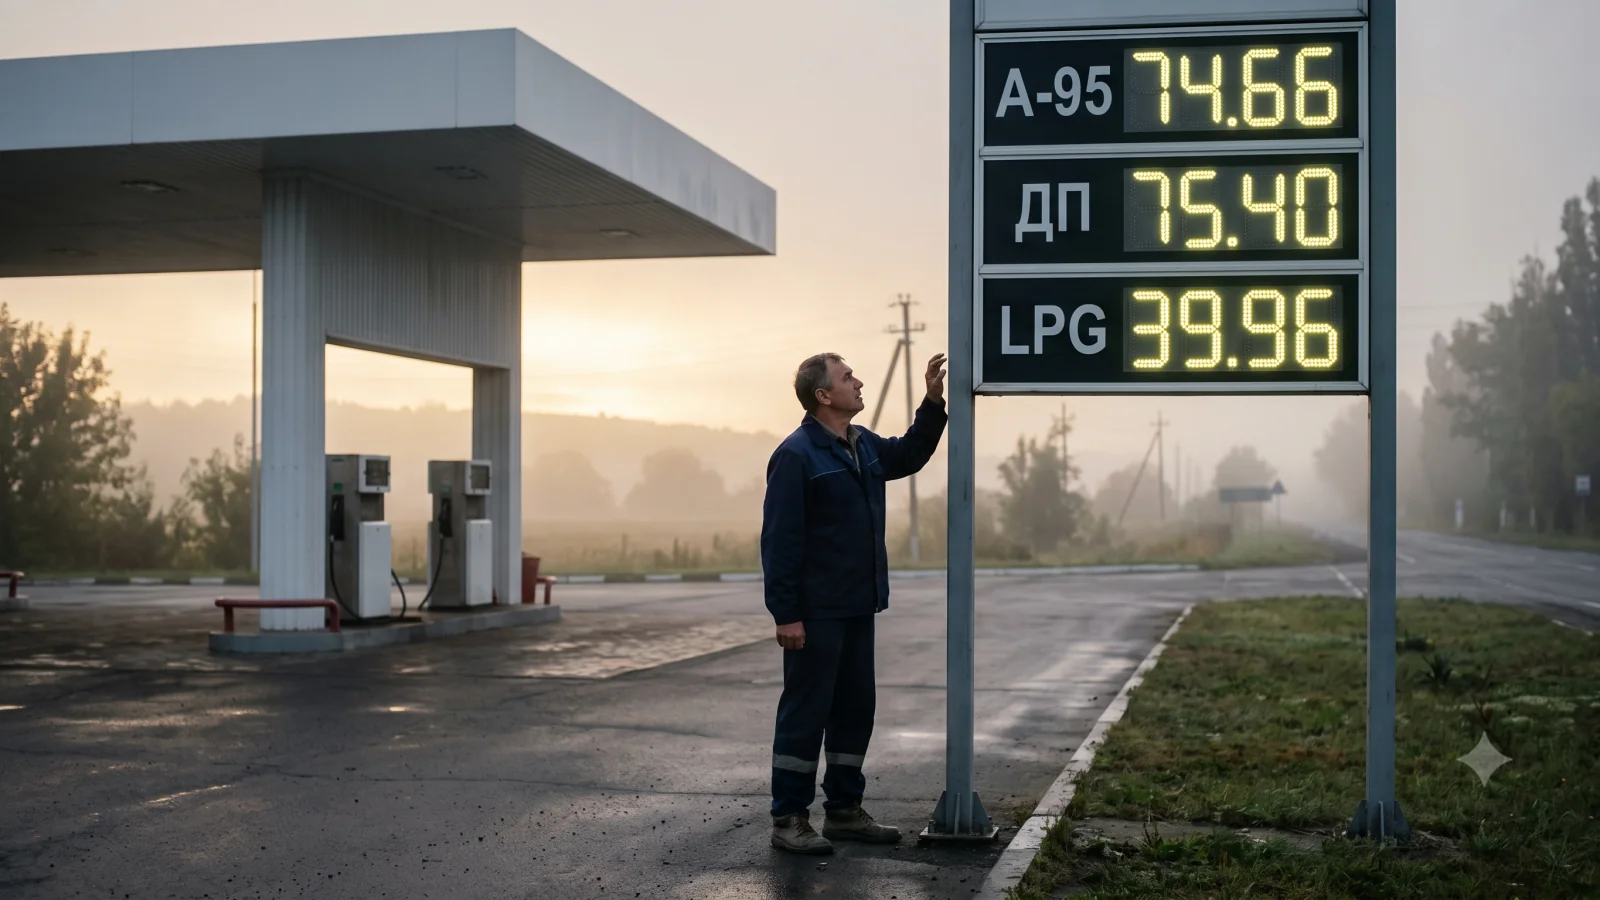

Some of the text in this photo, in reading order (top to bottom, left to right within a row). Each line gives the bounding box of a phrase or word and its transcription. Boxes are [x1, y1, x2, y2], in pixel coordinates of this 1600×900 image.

[1132, 46, 1338, 128] 74.66
[1015, 167, 1338, 249] ДП 75.40
[1001, 288, 1338, 369] LPG 39.96
